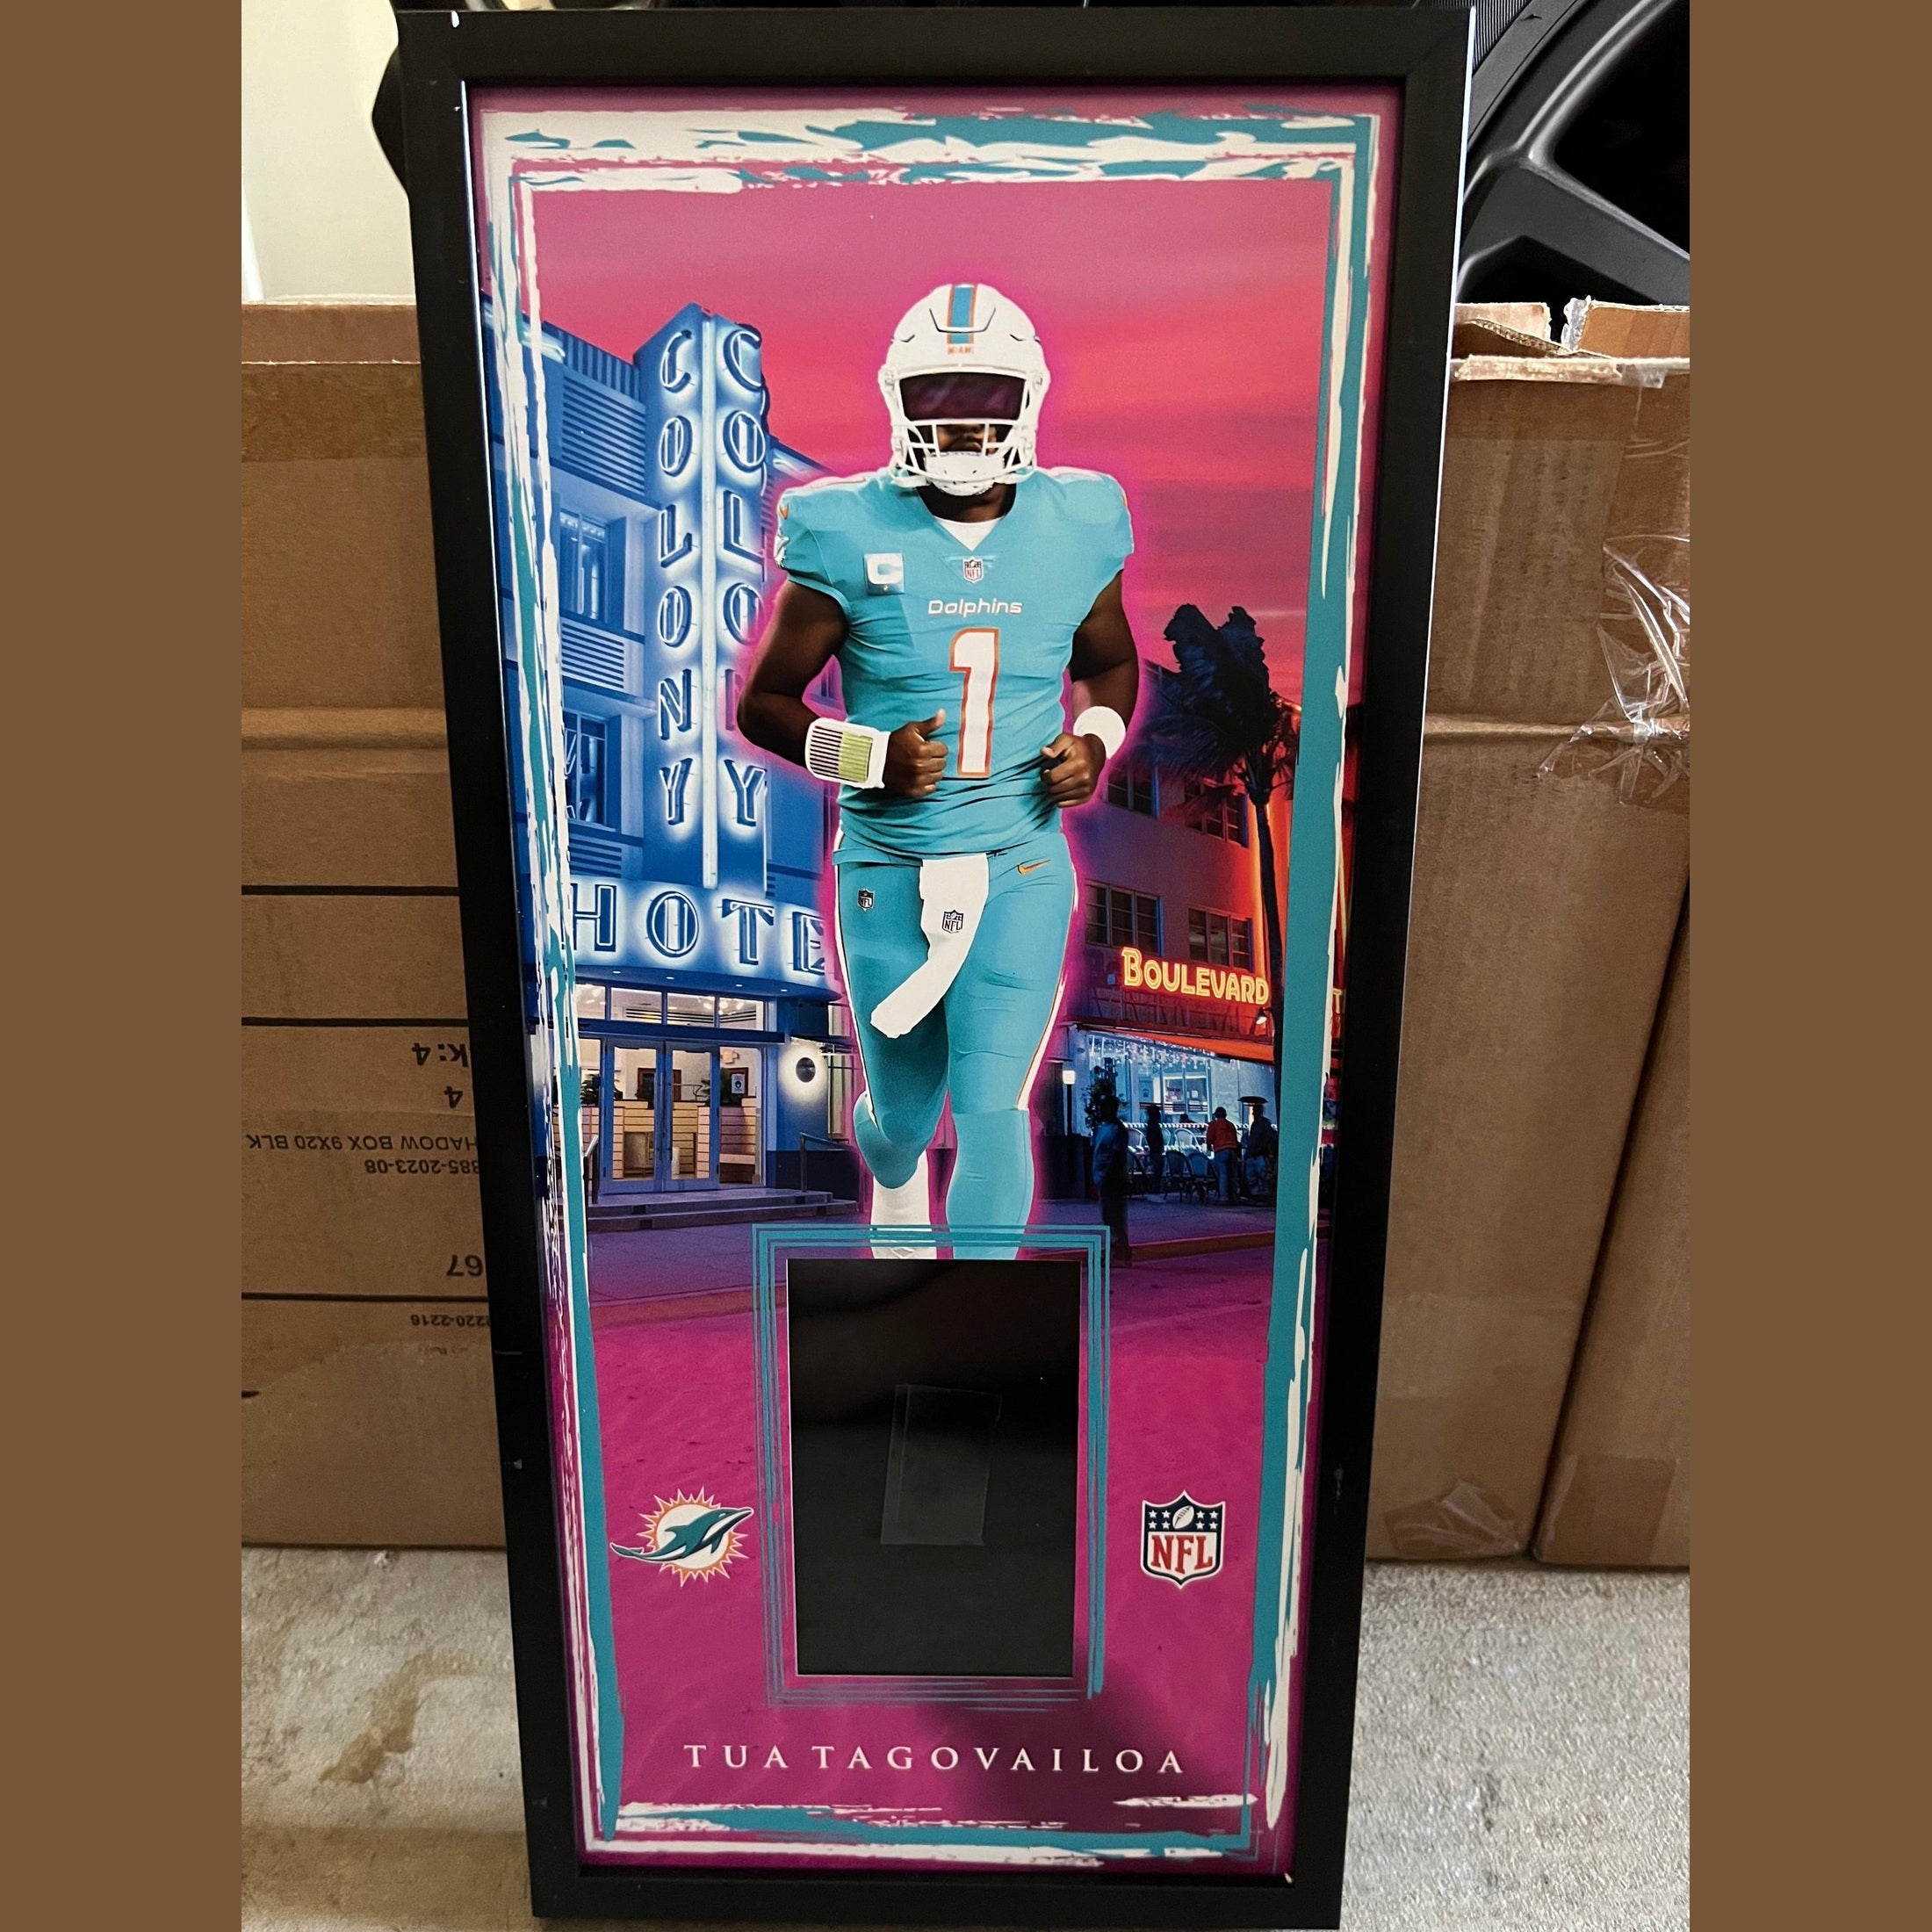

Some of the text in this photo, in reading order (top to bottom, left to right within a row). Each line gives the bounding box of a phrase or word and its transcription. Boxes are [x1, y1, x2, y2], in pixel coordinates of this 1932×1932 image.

[658, 328, 693, 825] COLONY
[928, 598, 1023, 618] Dolphins
[949, 627, 999, 778] 1
[1121, 947, 1270, 1006] BOULEVARD
[412, 1042, 431, 1066] 4
[443, 1085, 463, 1109] 4
[246, 1134, 288, 1150] BLK
[294, 1135, 343, 1150] 9X20
[349, 1135, 393, 1150] BOX
[1150, 1534, 1214, 1575] NFL
[683, 1745, 1184, 1773] TUA TAGOVAILOA
